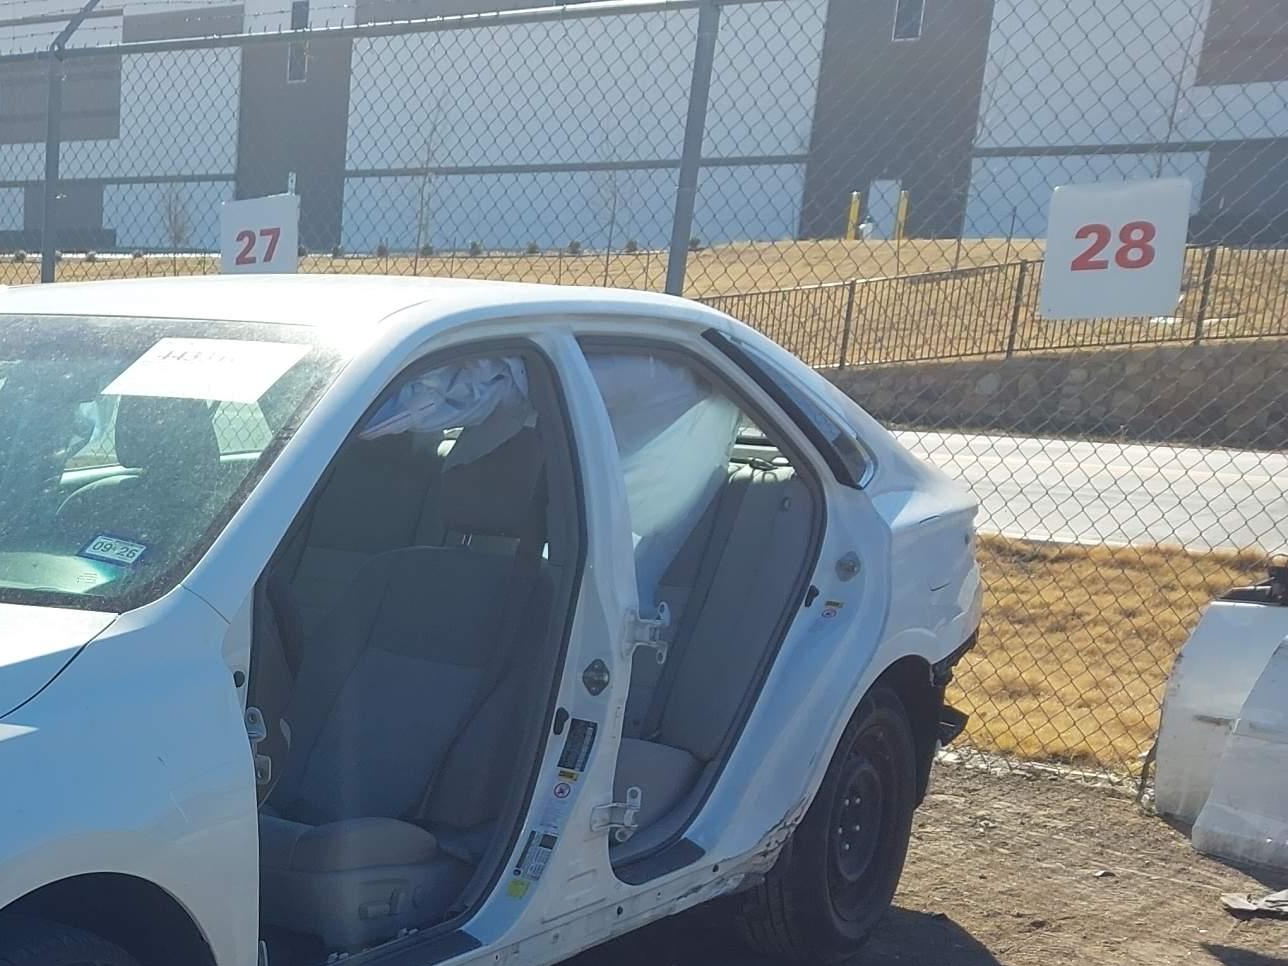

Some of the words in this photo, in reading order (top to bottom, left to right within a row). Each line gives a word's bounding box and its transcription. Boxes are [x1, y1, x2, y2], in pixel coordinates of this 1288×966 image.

[235, 227, 281, 266] 27
[1070, 220, 1156, 272] 28
[92, 541, 113, 553] 09
[117, 546, 139, 559] 26
